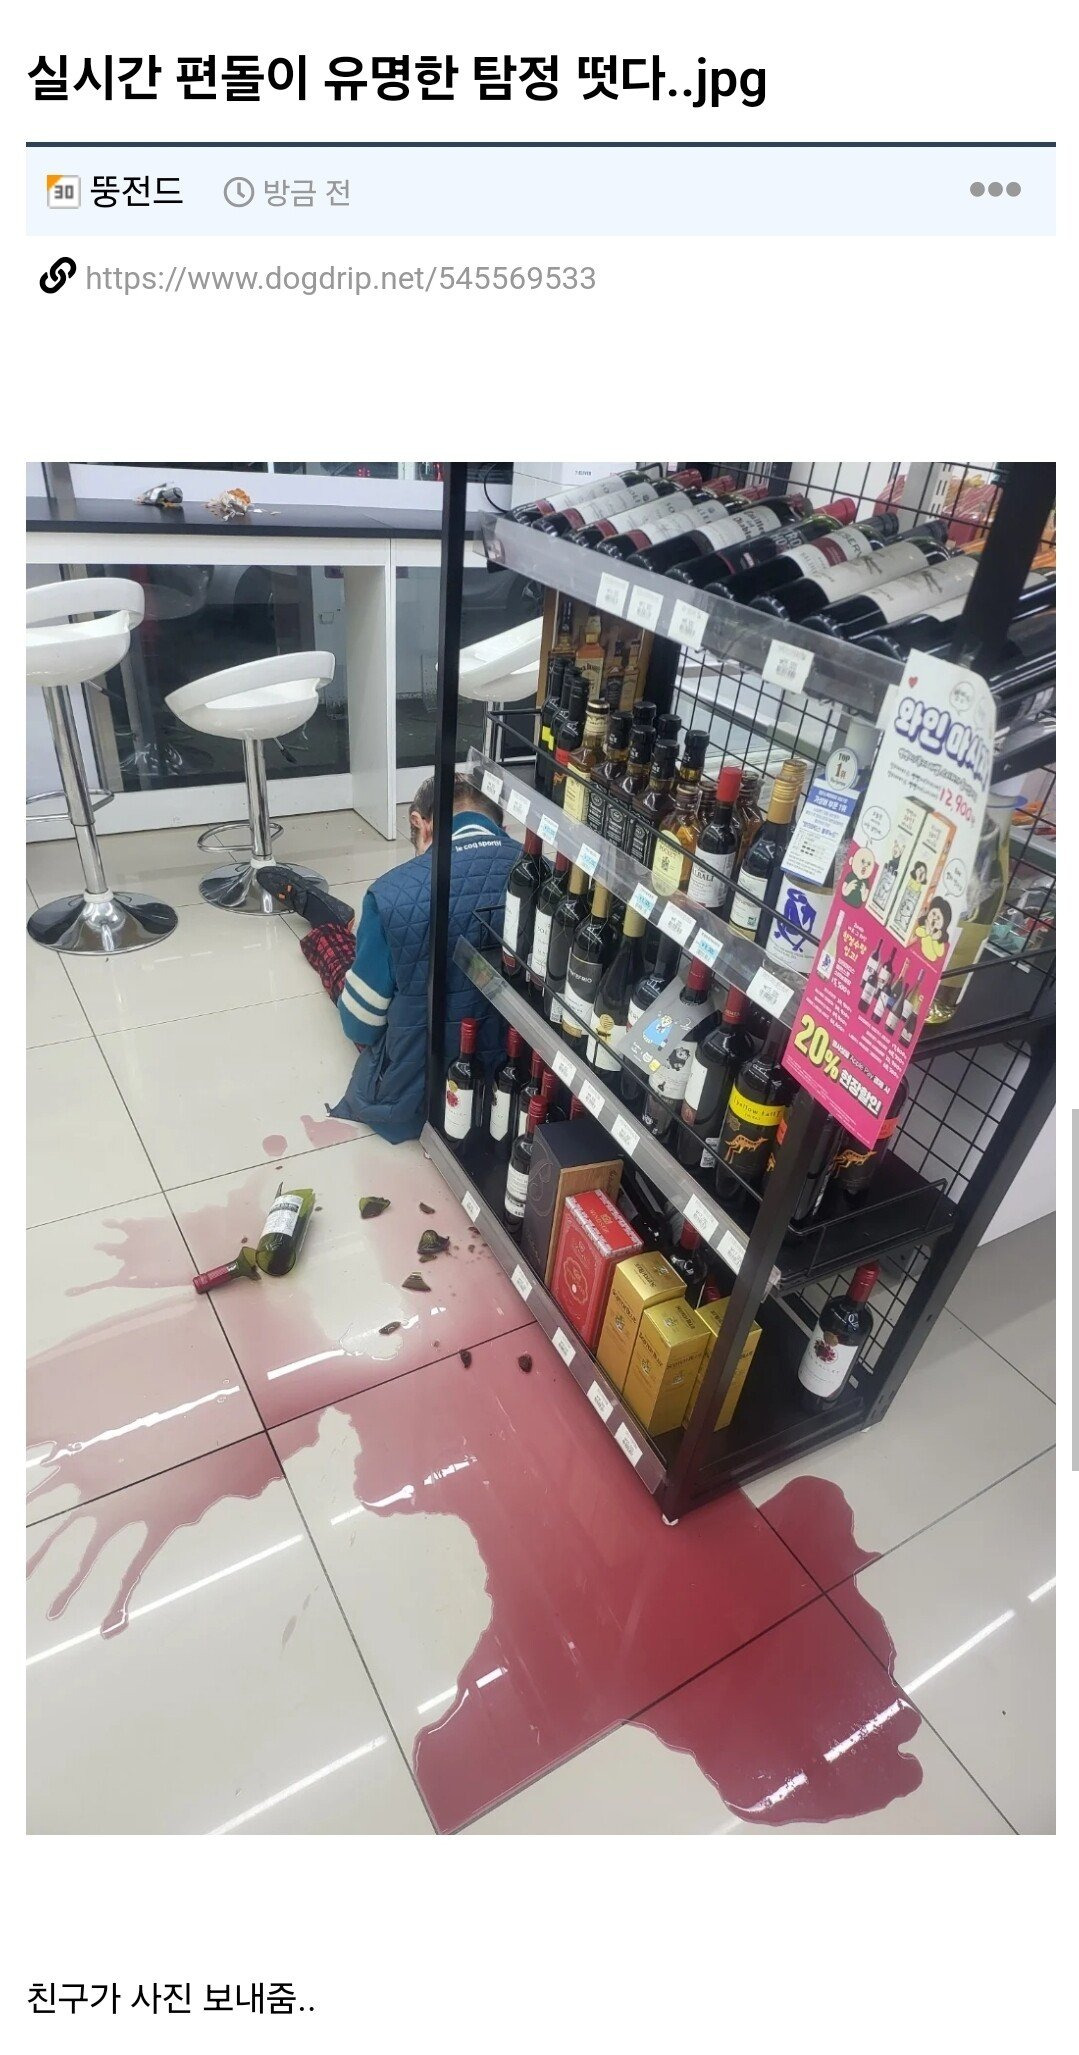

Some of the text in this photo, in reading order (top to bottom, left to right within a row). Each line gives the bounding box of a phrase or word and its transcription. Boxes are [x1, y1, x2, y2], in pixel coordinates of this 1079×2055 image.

[894, 696, 951, 755] 와인
[794, 1014, 840, 1080] 20%
[849, 1055, 865, 1071] Apple
[839, 1068, 883, 1116] 현장할인
